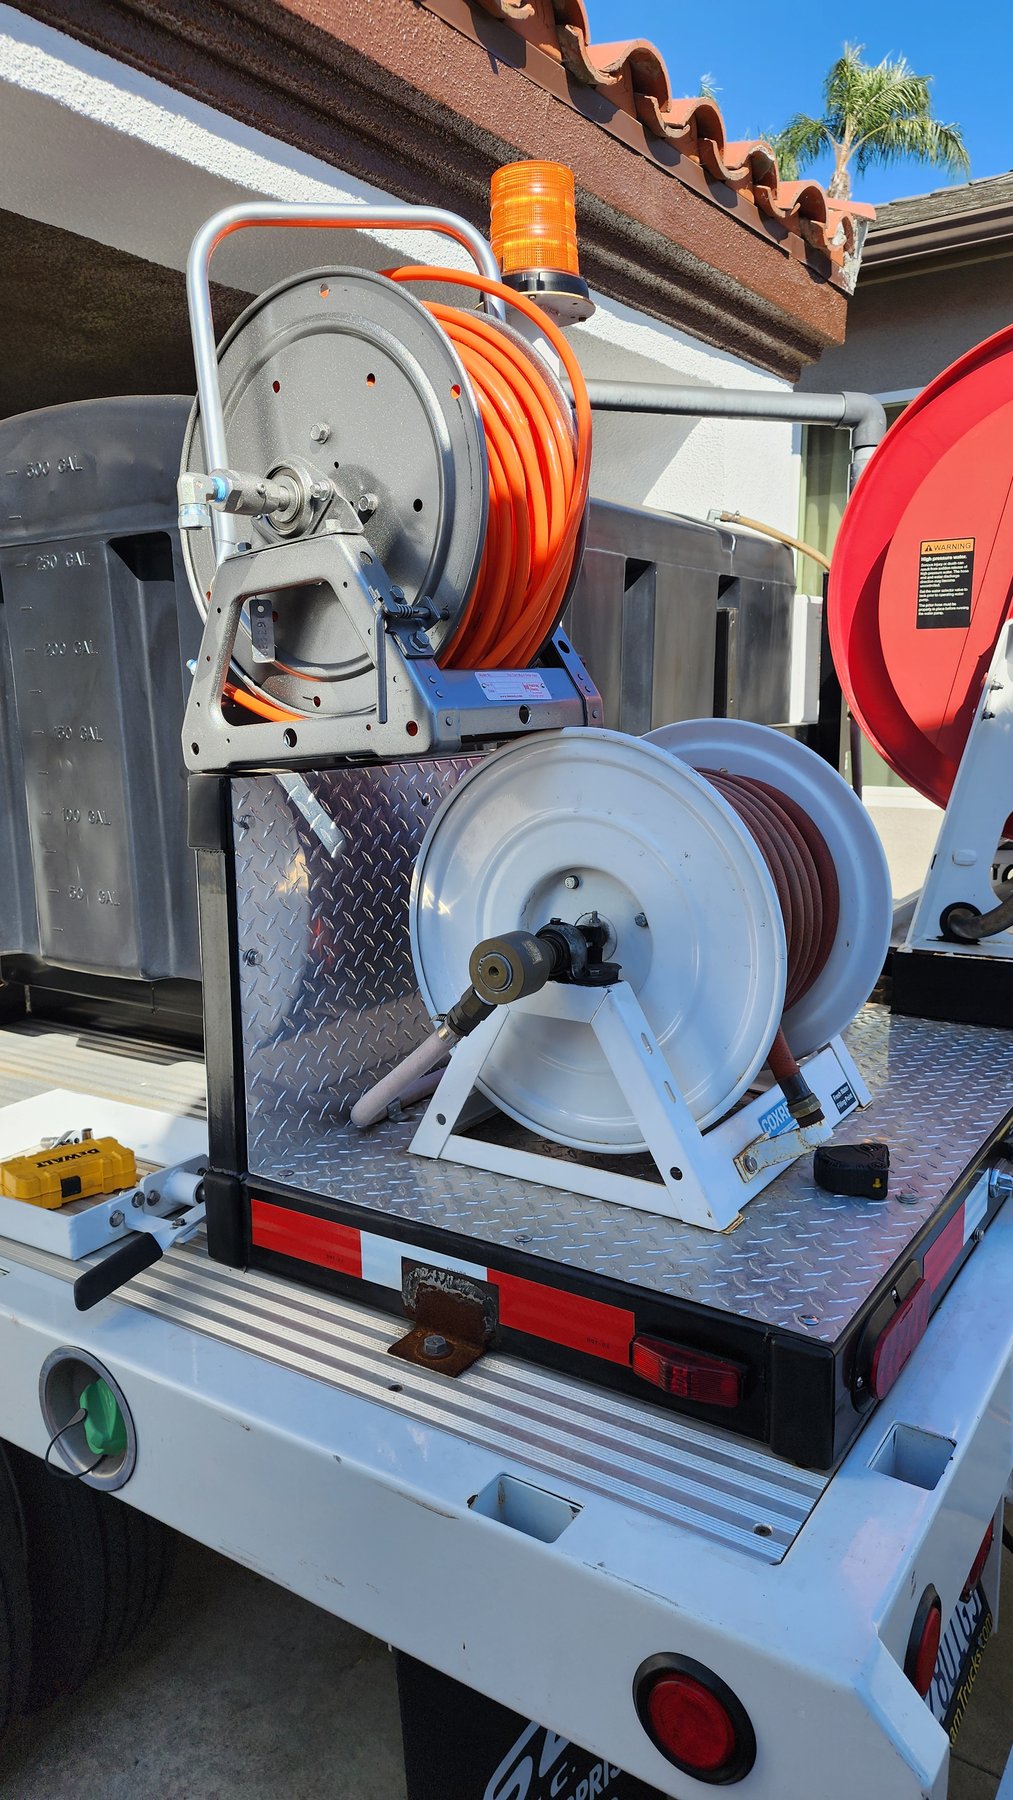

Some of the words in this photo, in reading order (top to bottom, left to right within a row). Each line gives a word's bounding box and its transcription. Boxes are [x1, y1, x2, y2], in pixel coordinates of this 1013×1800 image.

[57, 455, 83, 474] GAL
[933, 543, 972, 551] WARNING
[35, 554, 58, 570] 250
[65, 550, 91, 567] GAL
[73, 639, 99, 655] GAL
[53, 725, 73, 743] 150
[79, 725, 104, 743] GAL
[61, 807, 81, 824] 100
[88, 809, 112, 826] GAL
[68, 886, 84, 900] 50
[98, 889, 121, 906] GAL
[36, 1148, 100, 1168] DEWALT
